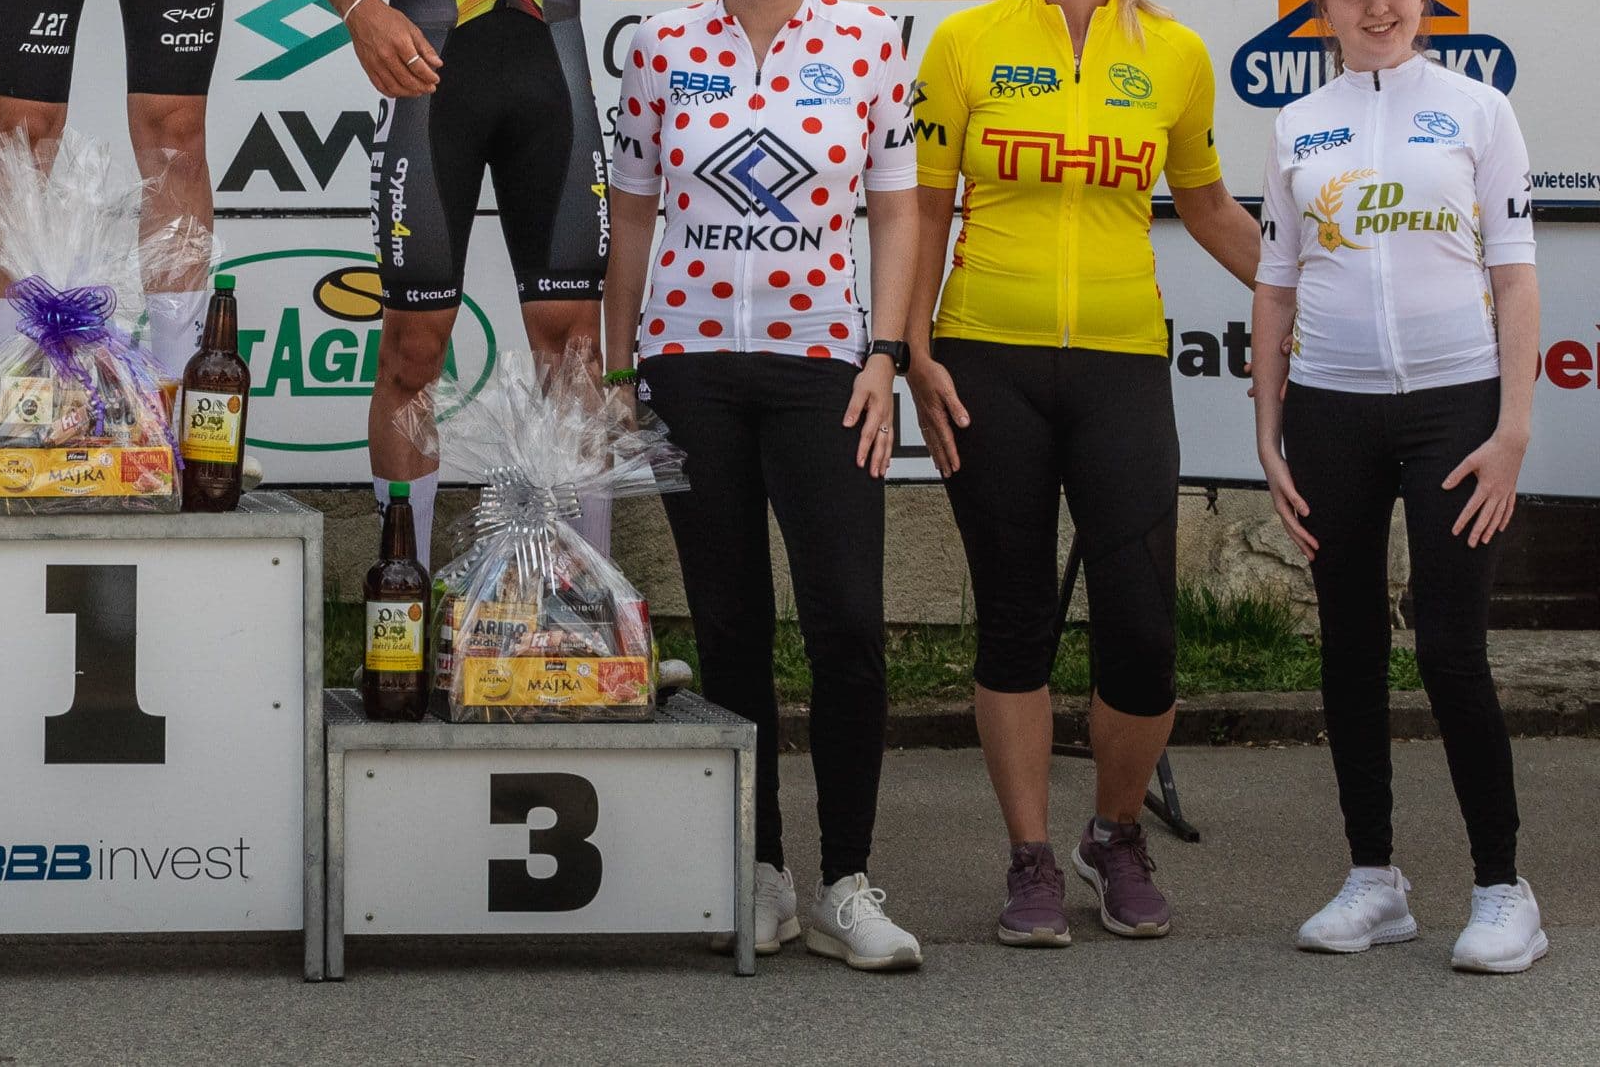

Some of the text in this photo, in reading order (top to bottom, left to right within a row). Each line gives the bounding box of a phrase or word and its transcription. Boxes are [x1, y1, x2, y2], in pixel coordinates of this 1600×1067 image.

[31, 13, 67, 36] L27
[161, 29, 214, 45] amic
[19, 43, 70, 55] RAYMON
[669, 70, 731, 92] RBB
[991, 65, 1057, 86] RBB
[981, 128, 1156, 191] THK
[1358, 182, 1404, 211] ZD
[389, 157, 412, 267] crypto4me
[1354, 206, 1459, 236] POPELÍN
[684, 224, 823, 252] NERKON
[473, 619, 528, 635] ARIBO
[44, 564, 166, 764] 1
[488, 772, 603, 912] 3
[99, 837, 250, 880] invest
